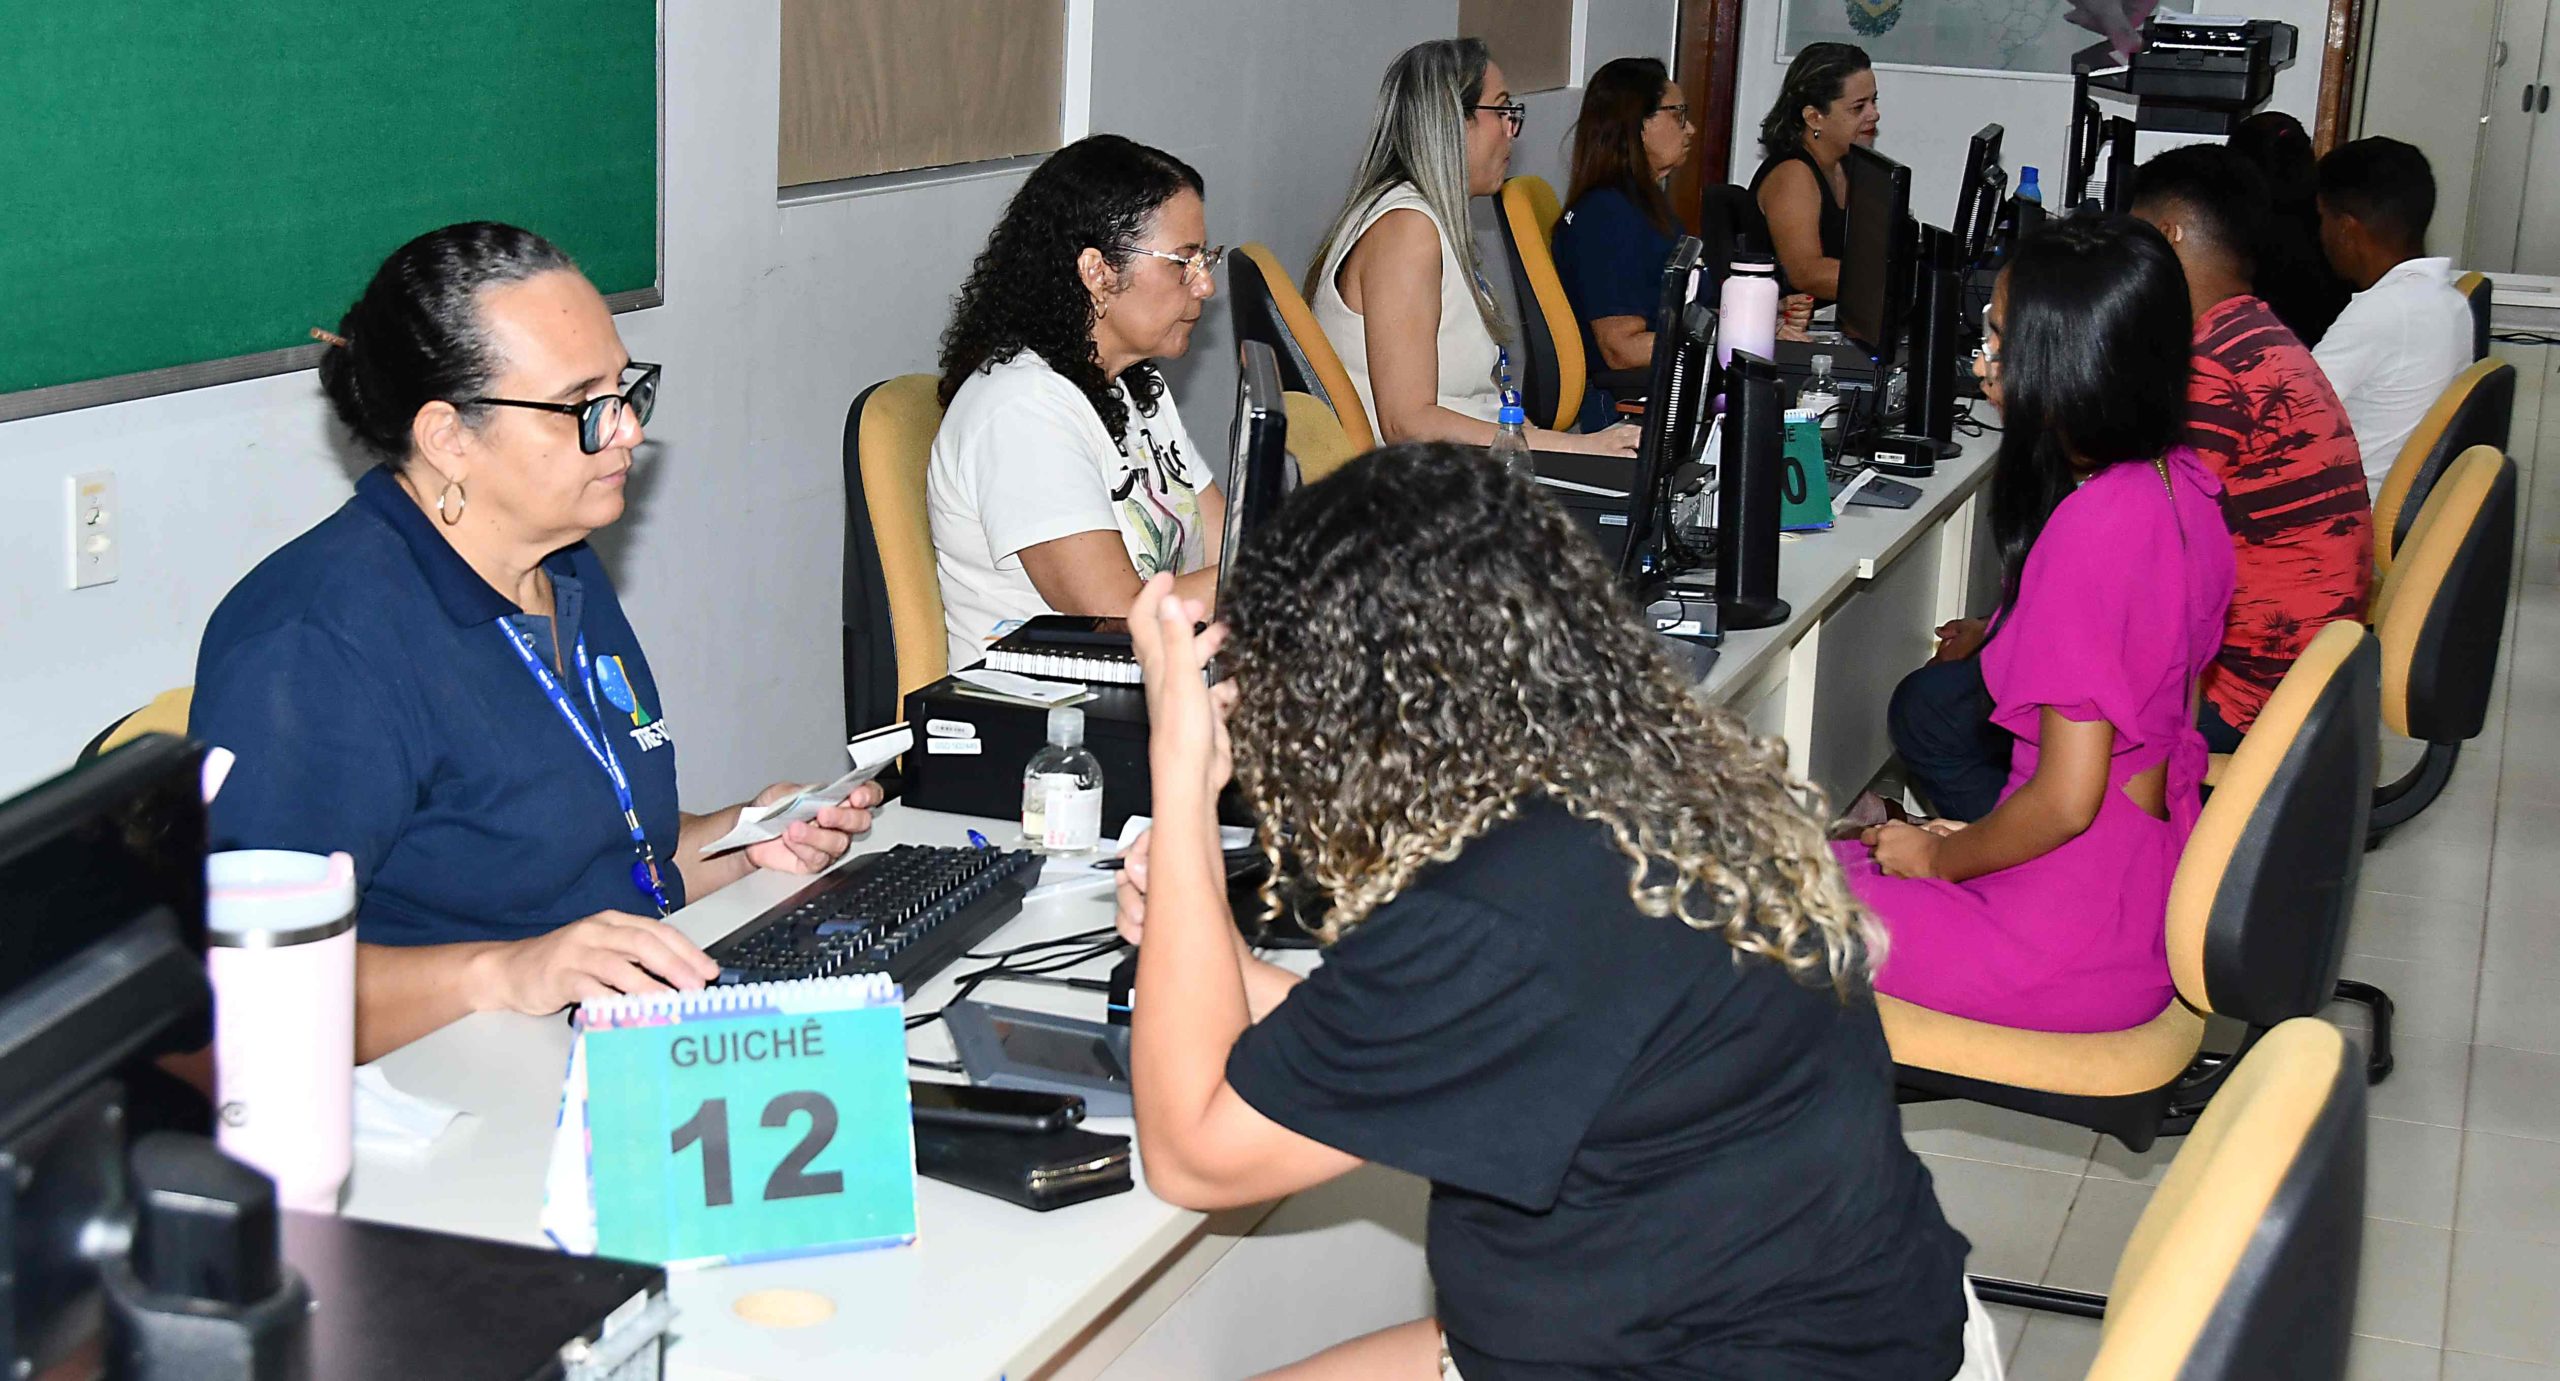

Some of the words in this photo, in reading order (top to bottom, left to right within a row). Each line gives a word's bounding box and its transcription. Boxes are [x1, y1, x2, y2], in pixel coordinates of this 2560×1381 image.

[1781, 456, 1807, 505] 0
[629, 718, 671, 752] TRE-T
[670, 1018, 825, 1068] GUICHÊ
[670, 1090, 845, 1207] 12
